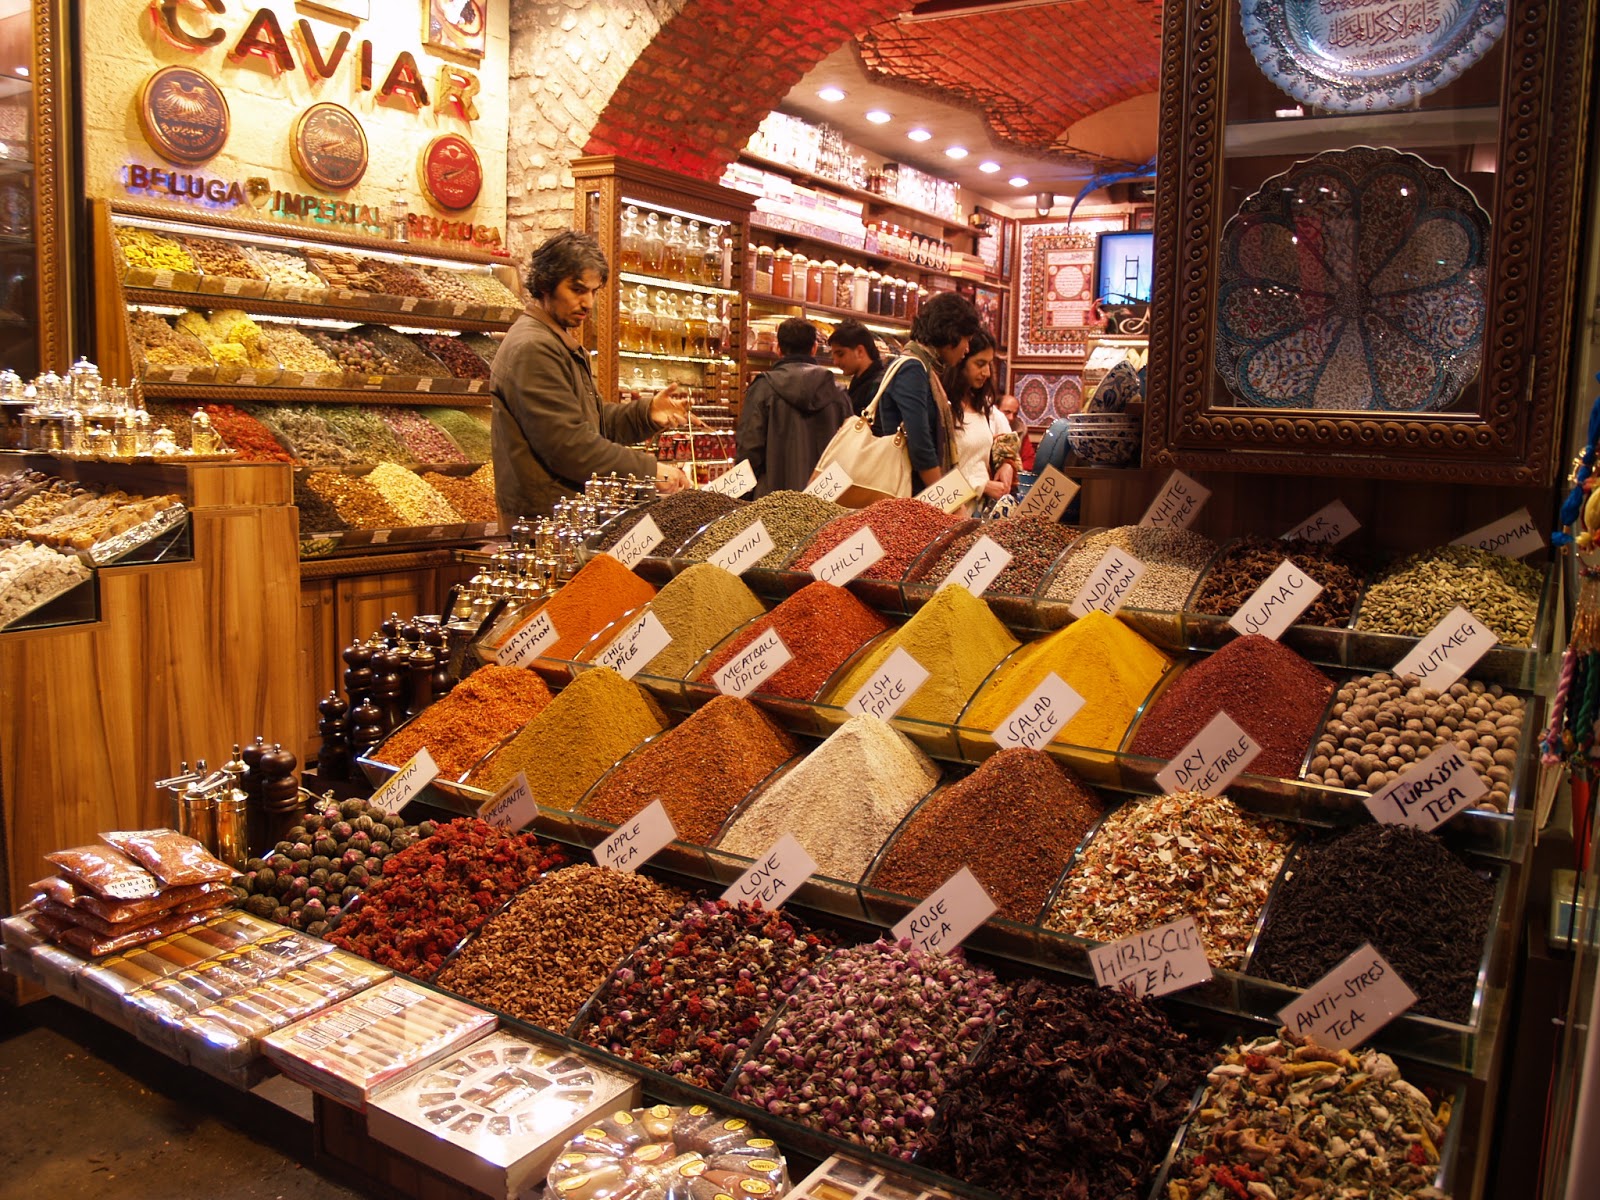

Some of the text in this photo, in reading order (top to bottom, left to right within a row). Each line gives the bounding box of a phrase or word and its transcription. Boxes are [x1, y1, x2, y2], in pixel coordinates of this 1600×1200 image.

[156, 0, 481, 121] CAVIAR
[130, 164, 244, 205] BELUGA
[273, 190, 381, 228] IMPERIAL
[1021, 476, 1056, 516] MIXED
[1168, 495, 1197, 528] PPER
[616, 532, 637, 559] HOT
[1293, 517, 1330, 539] TAR
[621, 535, 654, 566] APRICA
[718, 532, 762, 570] CUMIN
[820, 543, 866, 582] CHILLY
[1081, 558, 1124, 613] INDIAN
[1245, 574, 1304, 635] SUMAC
[497, 615, 546, 661] TURKISH
[505, 625, 551, 667] SAFFRON
[610, 643, 639, 672] SPICE
[722, 637, 778, 687] MEATBALL
[733, 659, 768, 692] SPICE
[858, 674, 892, 713] FISH
[871, 679, 907, 719] SPICE
[1007, 696, 1052, 742] SALAD
[1020, 710, 1058, 750] SPICE
[377, 764, 418, 806] JASMIN
[1174, 749, 1205, 785] DRY
[1383, 754, 1465, 818] TURKISH
[384, 784, 412, 810] TEA
[1421, 787, 1467, 823] TEA
[606, 822, 641, 858] APPLE
[612, 846, 639, 870] TEA
[110, 878, 152, 890] AFFRON
[740, 851, 781, 896] LOVE
[752, 878, 787, 903] TEA
[909, 898, 948, 940] ROSE
[920, 922, 952, 952] TEA
[1296, 960, 1385, 1033] ANTI-STRES
[1324, 1009, 1366, 1041] TEA
